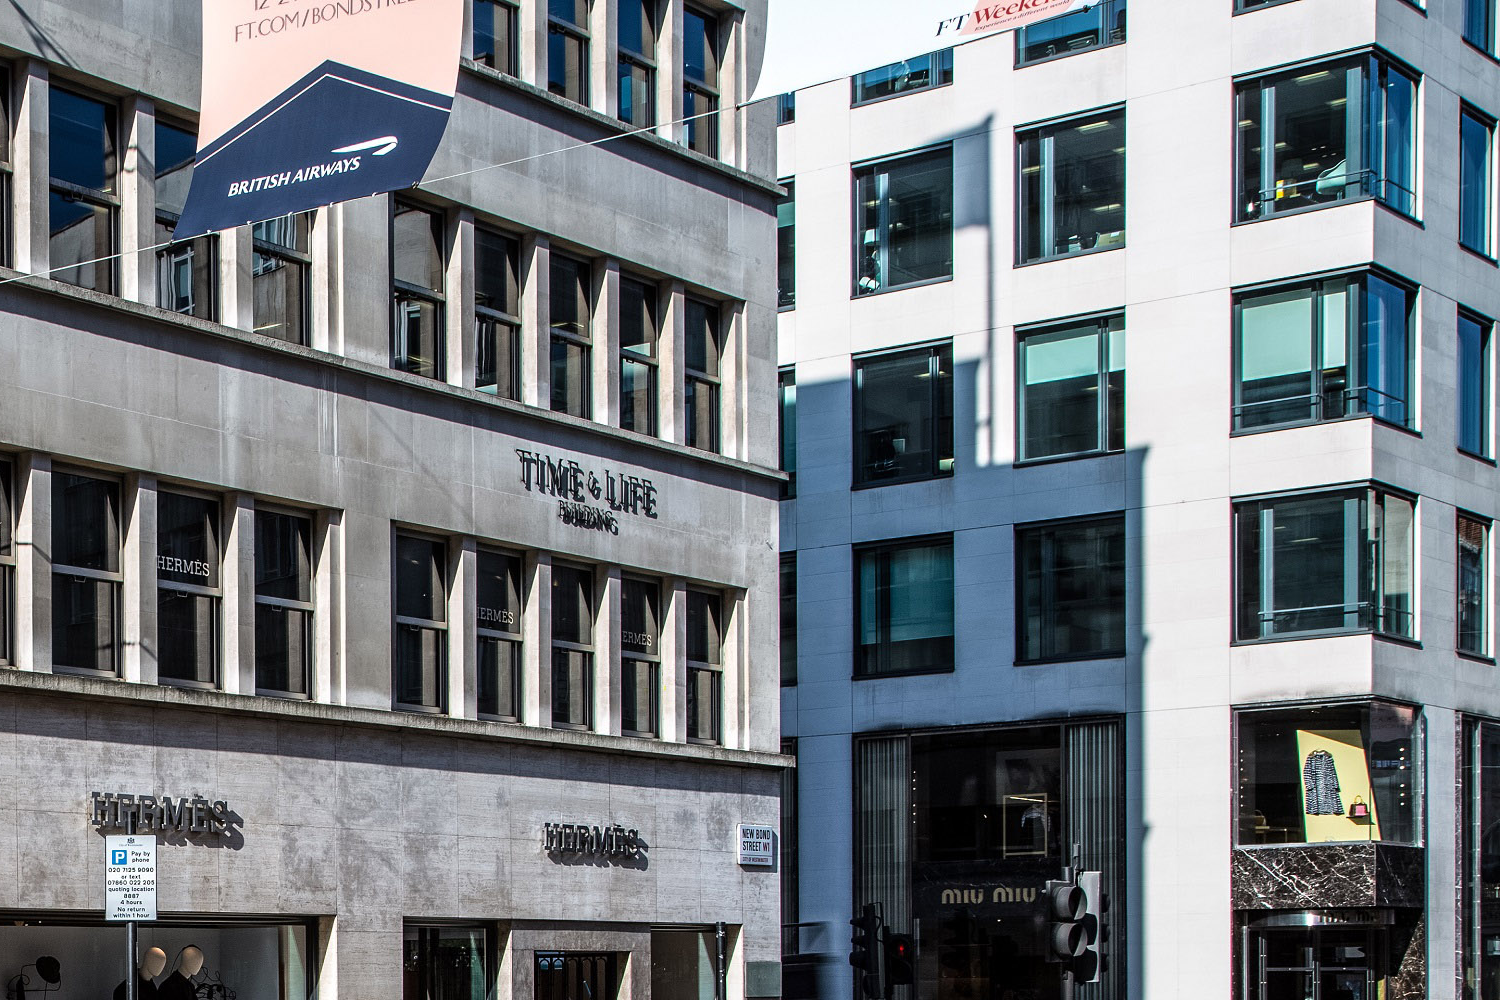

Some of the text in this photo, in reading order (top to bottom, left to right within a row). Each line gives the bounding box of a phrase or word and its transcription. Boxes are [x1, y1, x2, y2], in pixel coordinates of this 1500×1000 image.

[235, 0, 418, 42] FT.COM/BONDS
[973, 0, 1054, 24] Weeke
[228, 156, 361, 197] BRITISH AIRWAYS
[515, 449, 582, 497] TIME
[605, 470, 655, 515] LIFE
[742, 829, 771, 840] NEW BOND
[742, 841, 770, 852] STREET W1
[115, 852, 125, 863] P
